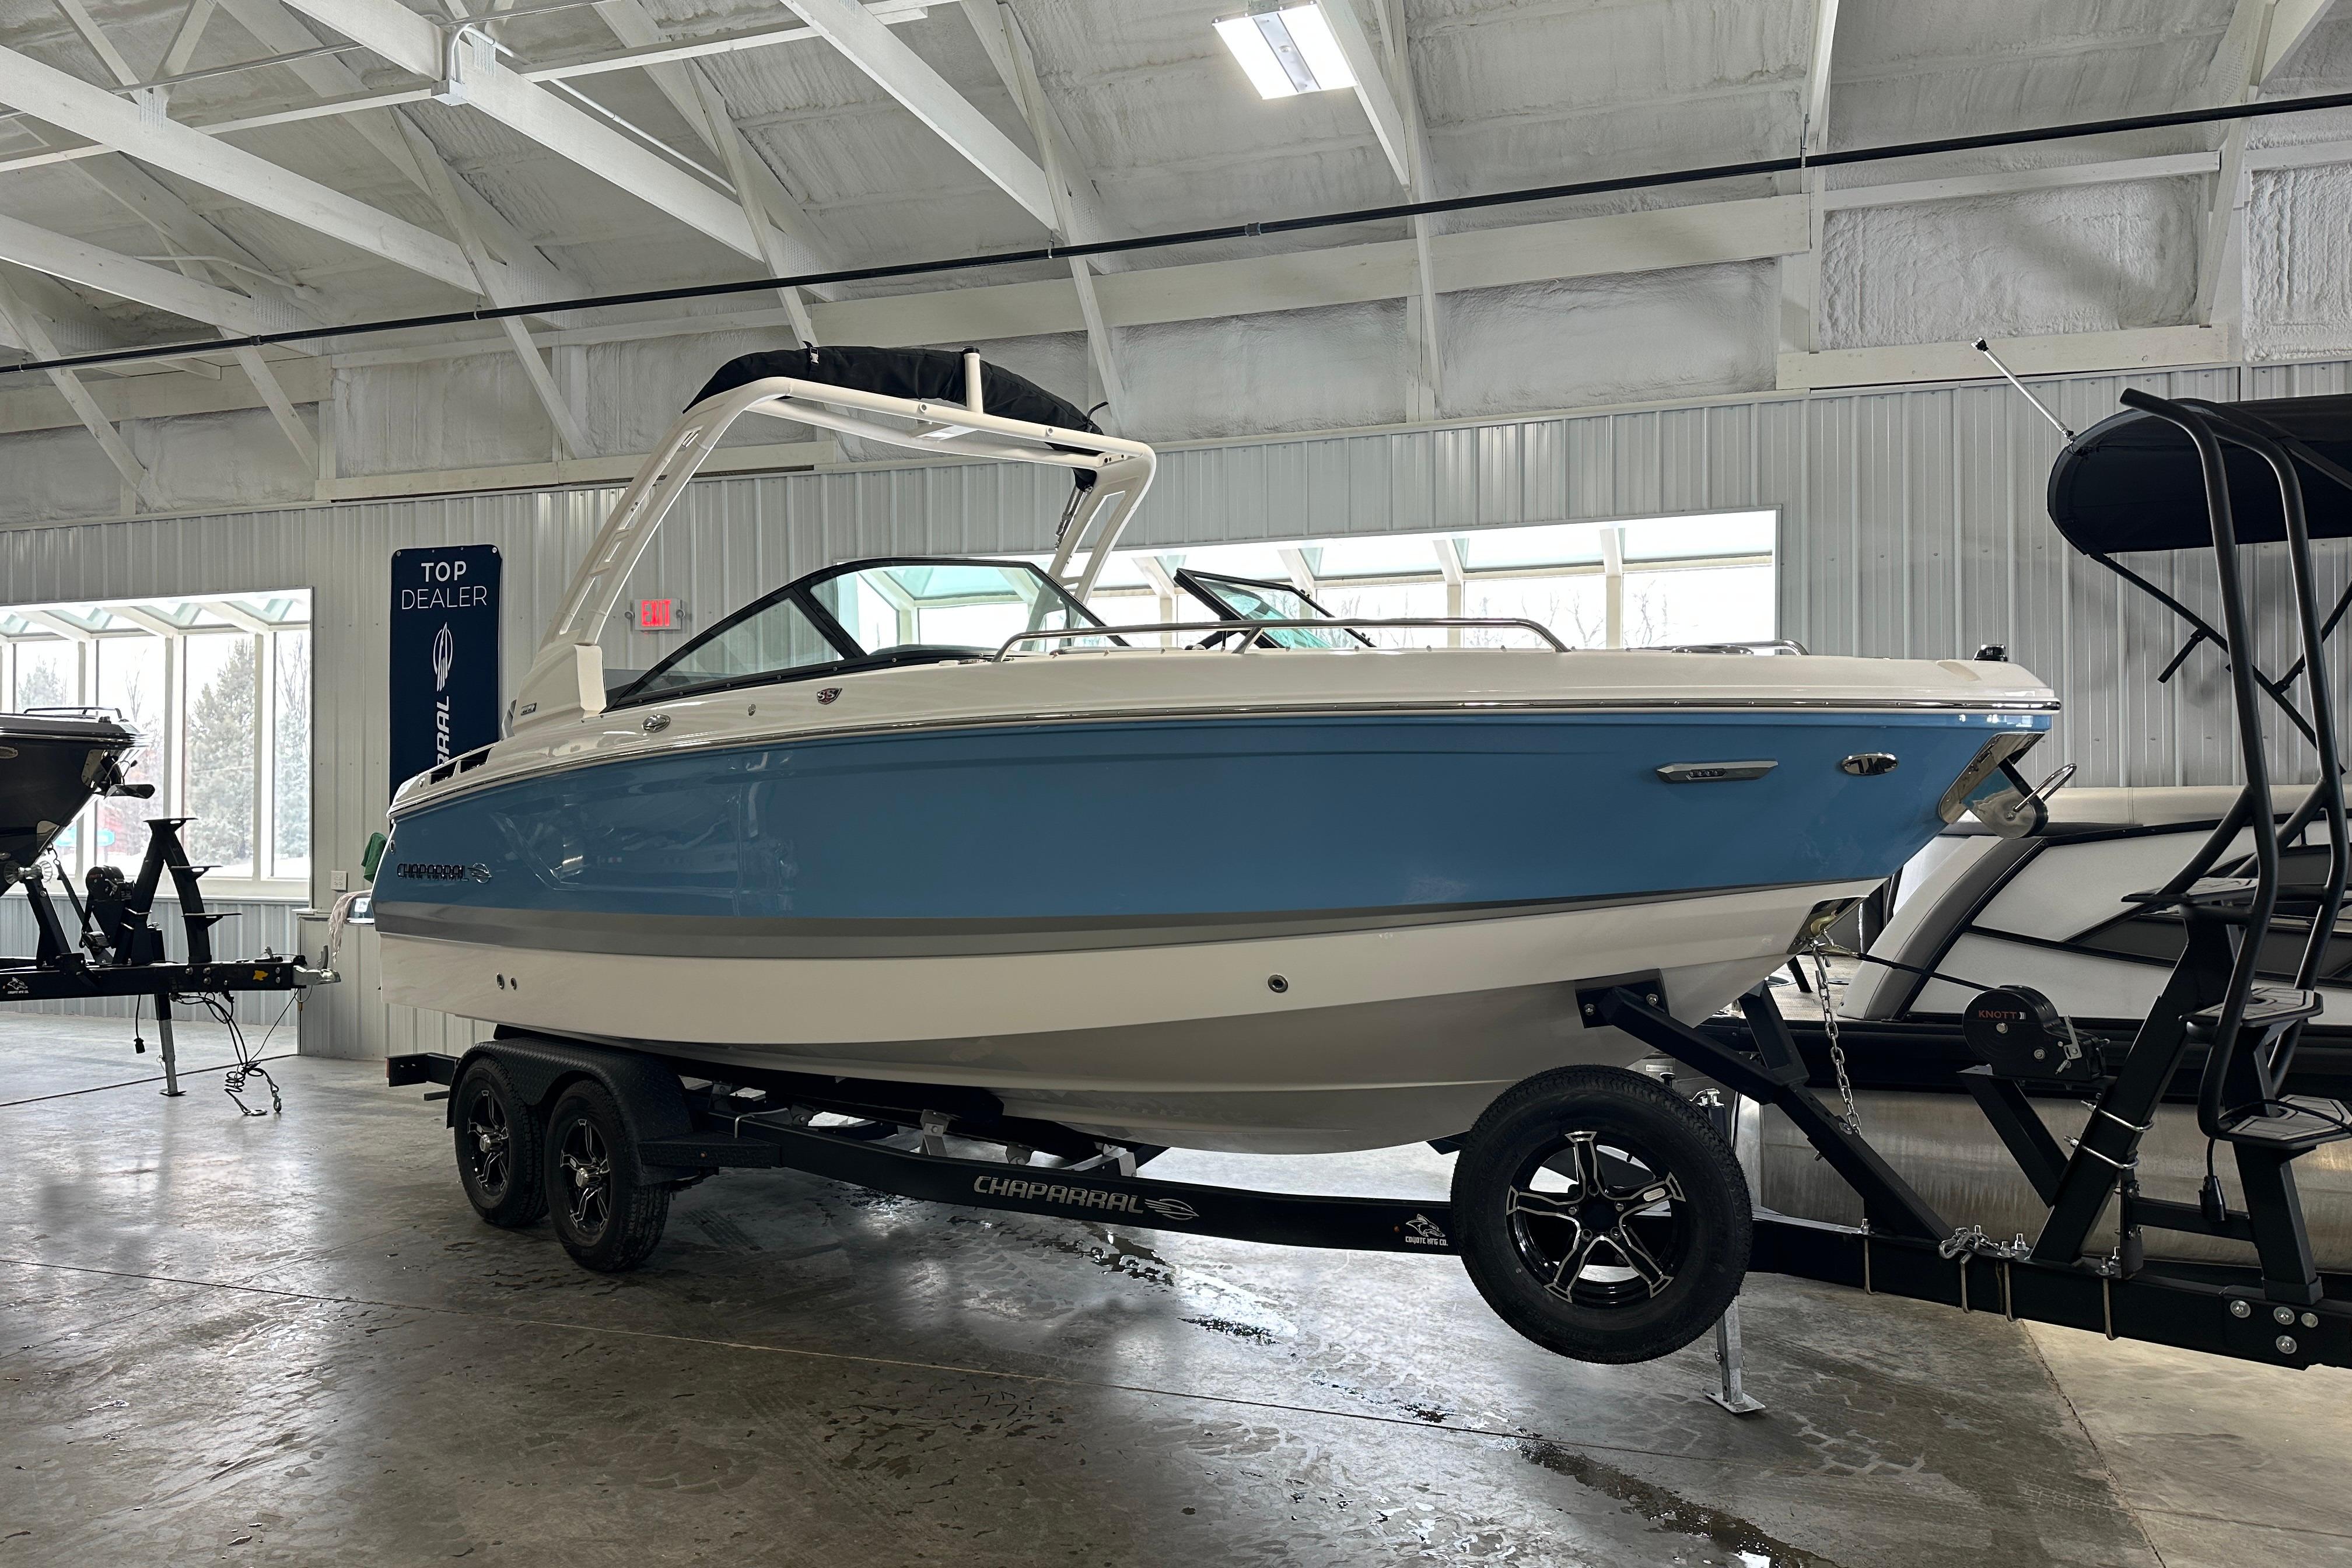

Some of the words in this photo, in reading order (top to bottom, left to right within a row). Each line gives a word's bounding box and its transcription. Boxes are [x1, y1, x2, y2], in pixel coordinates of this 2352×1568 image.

[421, 561, 467, 582] TOP
[402, 586, 487, 610] DEALER
[641, 599, 671, 626] EXIT
[397, 863, 469, 882] CHAPARRAL
[1978, 1010, 2017, 1020] KNOTT
[974, 1175, 1143, 1214] CHAPARRAL
[1405, 1236, 1426, 1244] COYOTE
